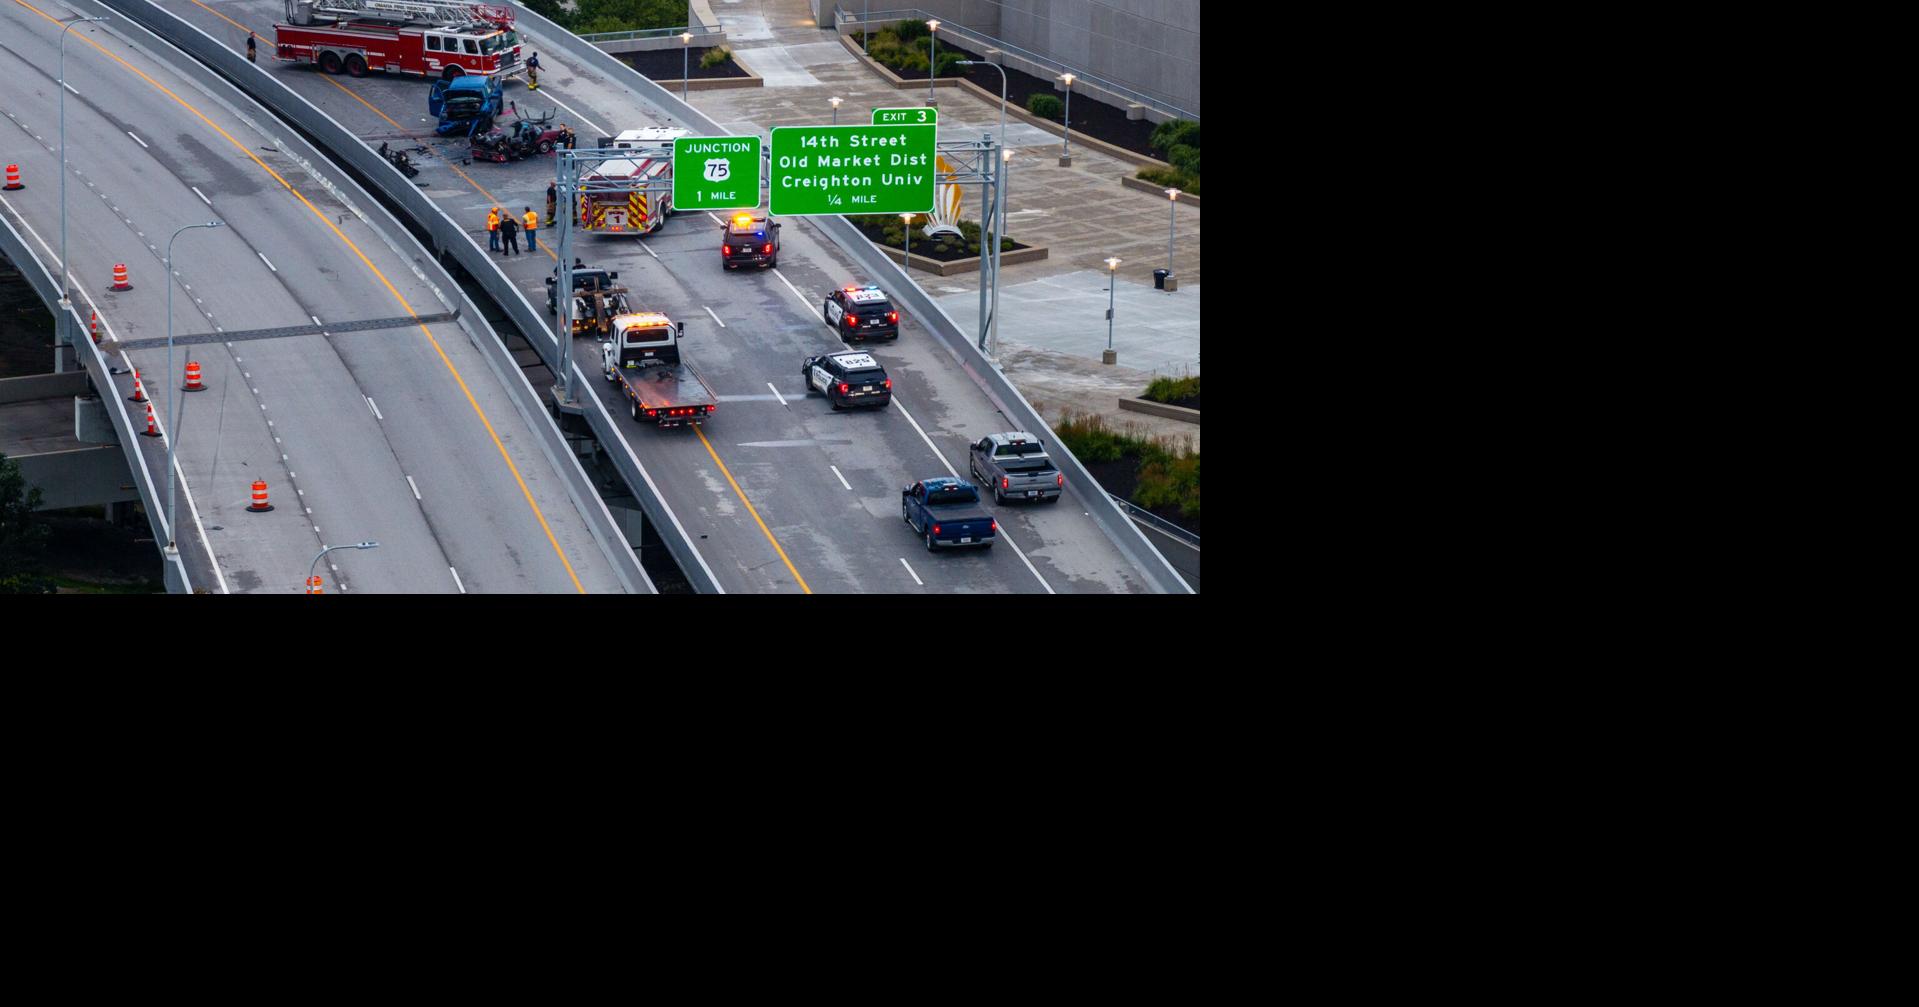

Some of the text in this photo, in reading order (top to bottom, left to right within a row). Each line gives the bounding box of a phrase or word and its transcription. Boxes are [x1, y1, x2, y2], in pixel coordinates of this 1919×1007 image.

[882, 111, 927, 122] EXIT 3
[800, 134, 907, 148] 14th Street
[685, 142, 750, 154] JUNCTION
[779, 153, 927, 168] Old Market Dist
[707, 163, 728, 177] 75
[782, 173, 923, 190] Creighton Univ
[696, 191, 736, 202] 1 MILE
[851, 195, 877, 204] MILE
